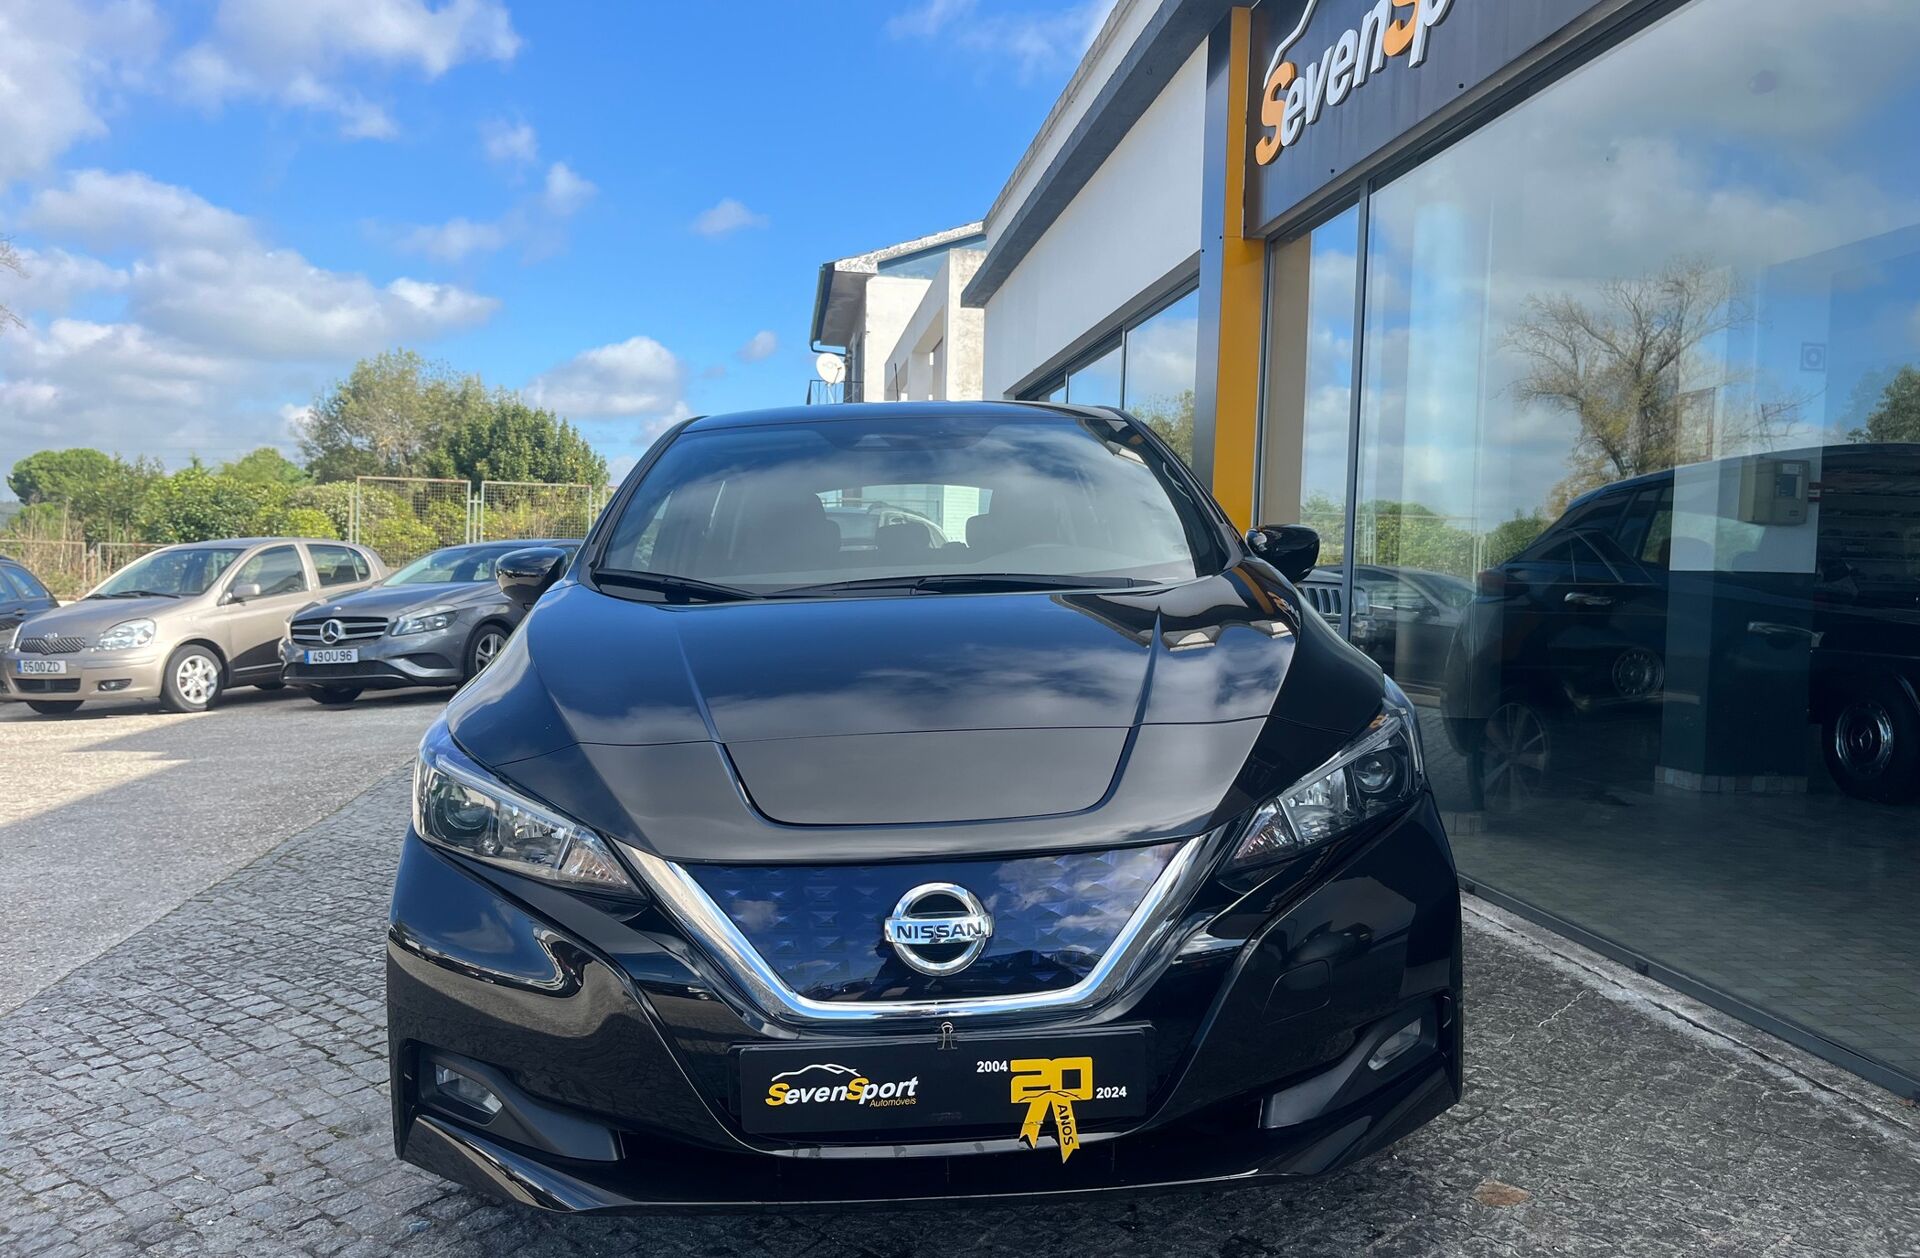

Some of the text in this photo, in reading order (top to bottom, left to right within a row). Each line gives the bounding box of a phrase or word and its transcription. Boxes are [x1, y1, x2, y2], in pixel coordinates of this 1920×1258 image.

[896, 922, 982, 939] NISSAN
[976, 1060, 1009, 1073] 2004
[1010, 1056, 1094, 1104] 20
[765, 1076, 919, 1106] SevenSport
[1096, 1086, 1128, 1099] 2024
[869, 1096, 917, 1108] Automóveis
[1057, 1104, 1075, 1146] ANOS
